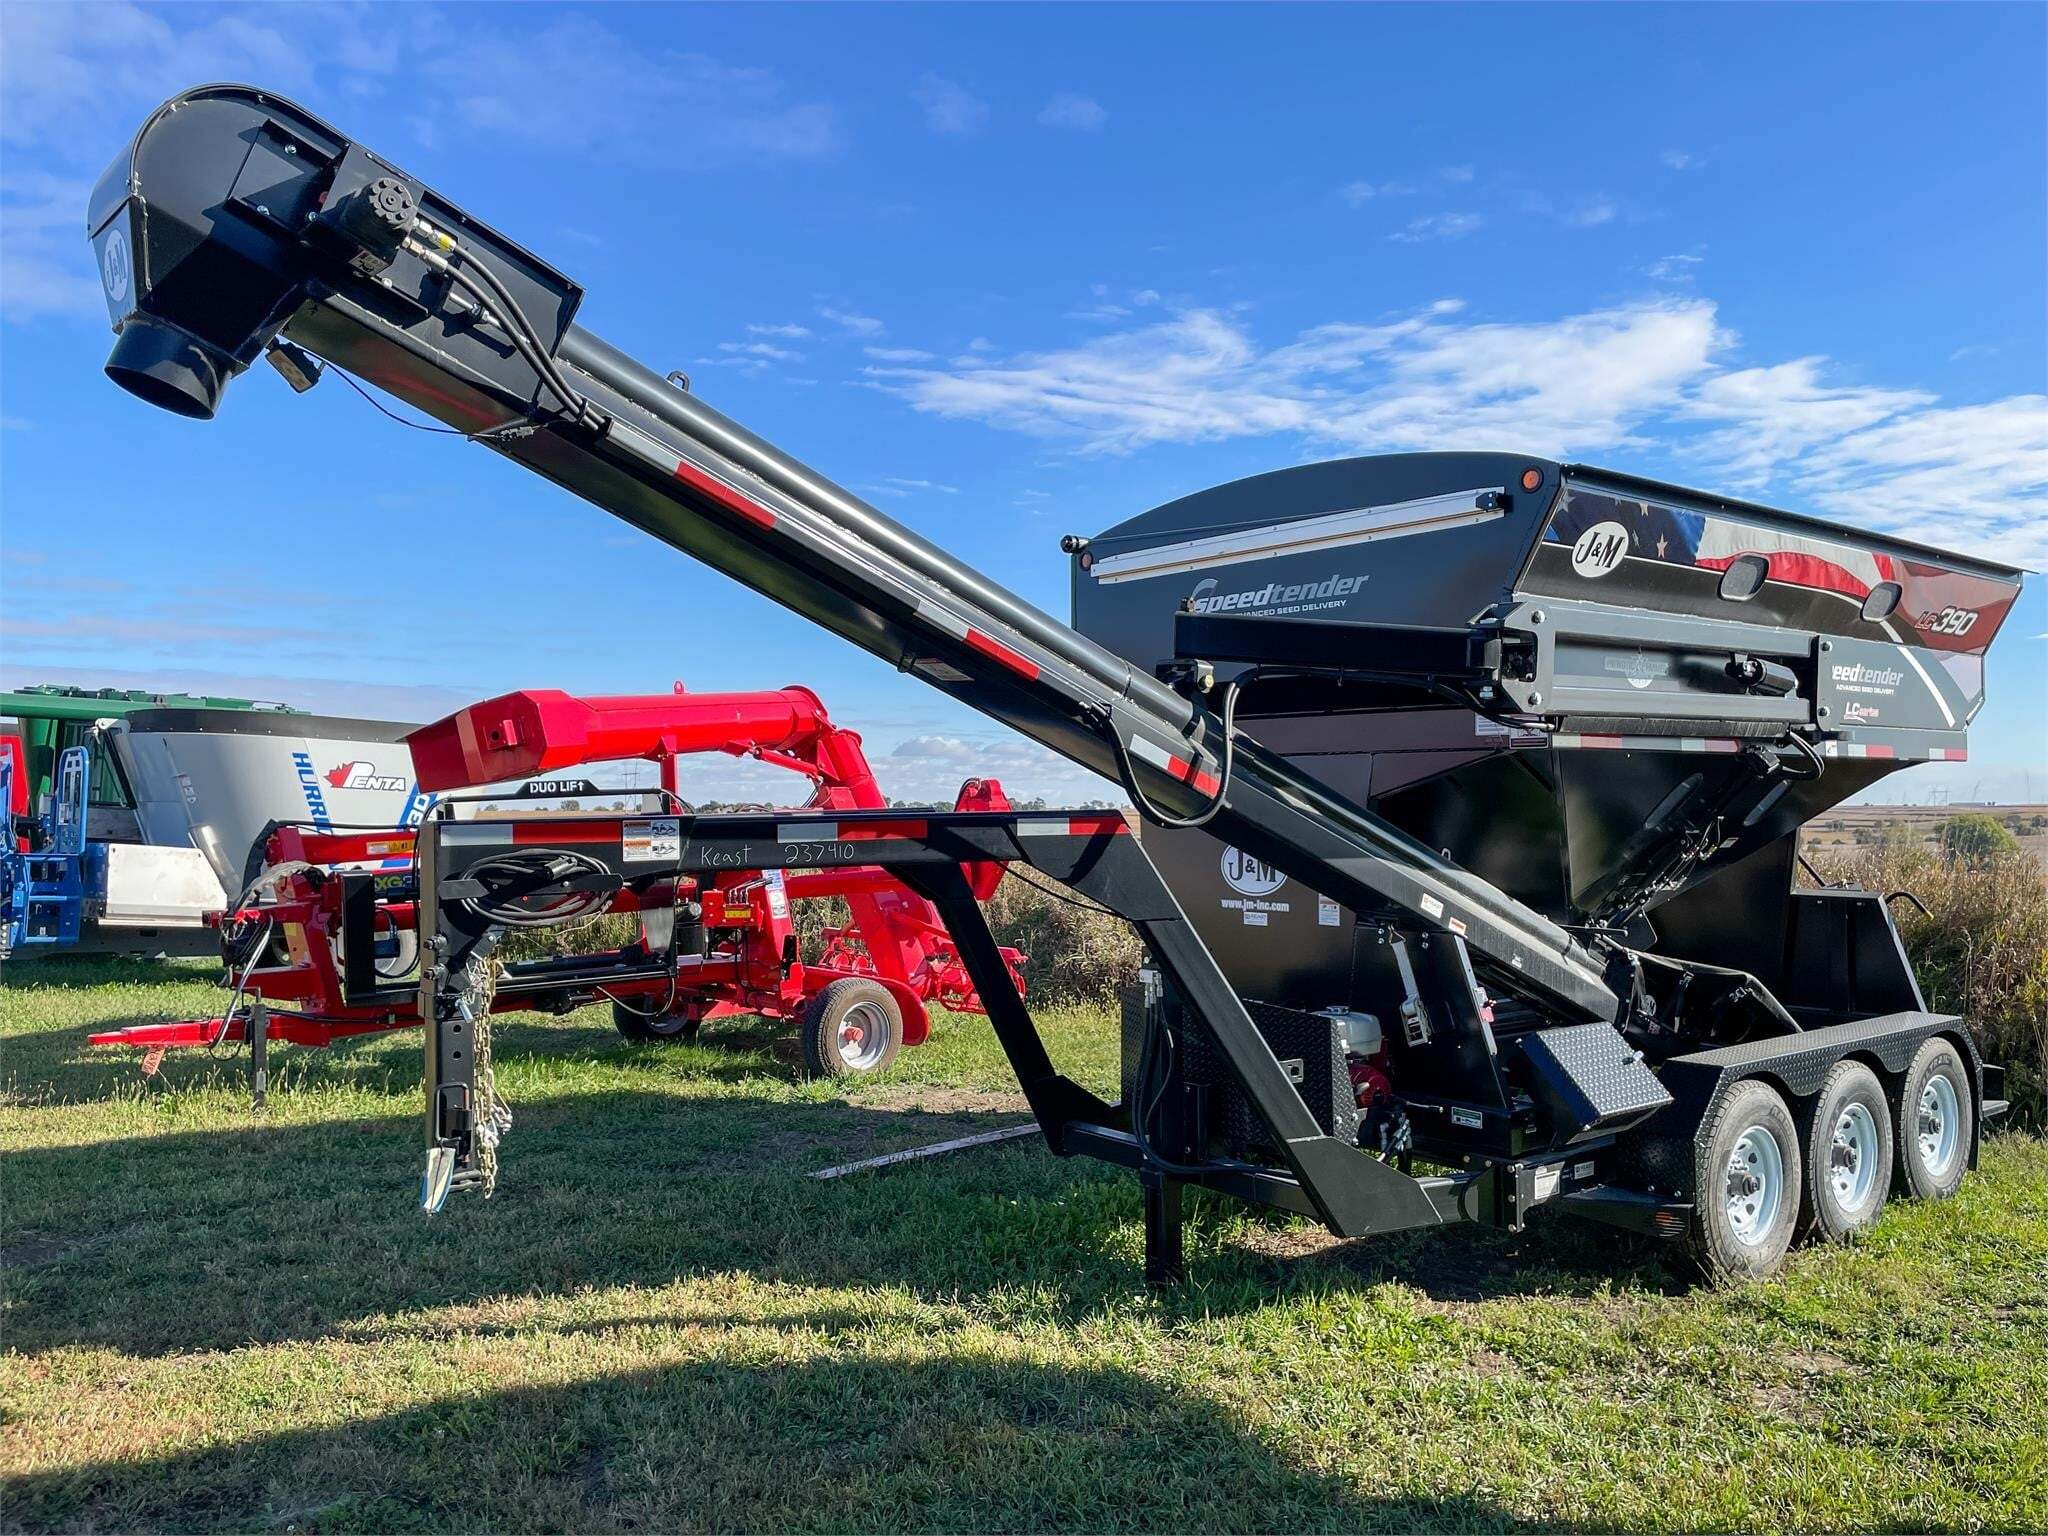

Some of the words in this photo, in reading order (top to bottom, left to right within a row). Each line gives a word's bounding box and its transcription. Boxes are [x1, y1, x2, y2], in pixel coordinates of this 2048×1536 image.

[1574, 531, 1626, 569] J&M
[1276, 604, 1300, 615] SEED
[1301, 599, 1348, 612] DELIVERY
[1832, 663, 1904, 687] eedtender
[529, 782, 556, 794] DUO
[700, 843, 753, 866] Keast
[784, 843, 856, 864] 237410
[1227, 849, 1277, 883] J&M
[1221, 898, 1290, 913] www.jm-inc.com
